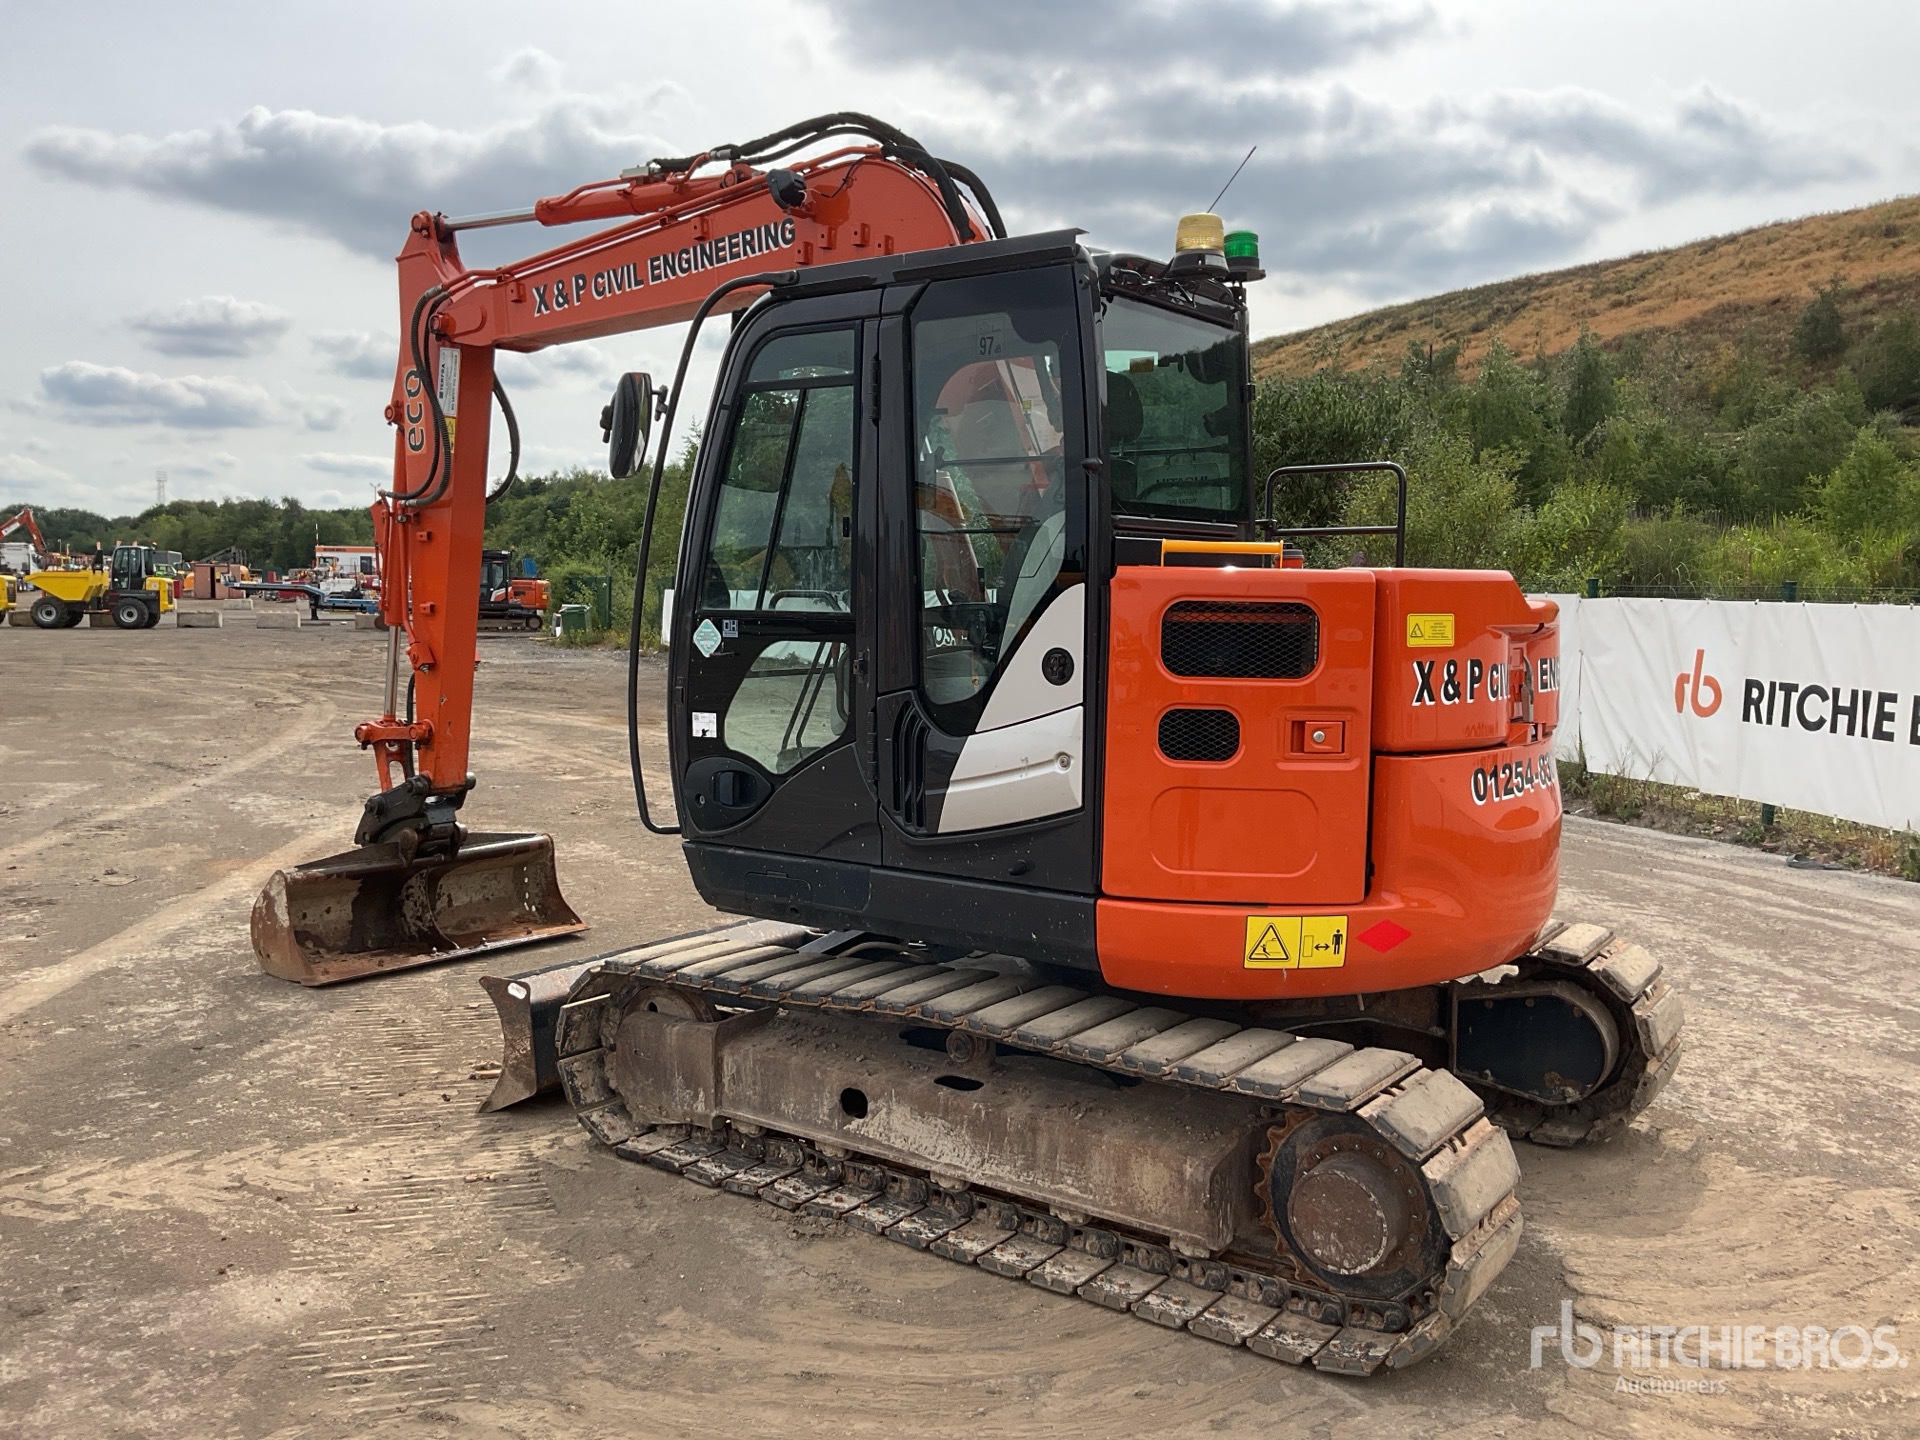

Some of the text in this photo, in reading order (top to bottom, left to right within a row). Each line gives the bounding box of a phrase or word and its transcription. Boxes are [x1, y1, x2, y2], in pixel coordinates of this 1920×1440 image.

[533, 217, 796, 317] X & P CIVIL ENGINEERING
[1412, 660, 1436, 706] X
[1440, 658, 1462, 705] &
[1466, 658, 1483, 704] P
[1742, 678, 1899, 743] RITCHIE
